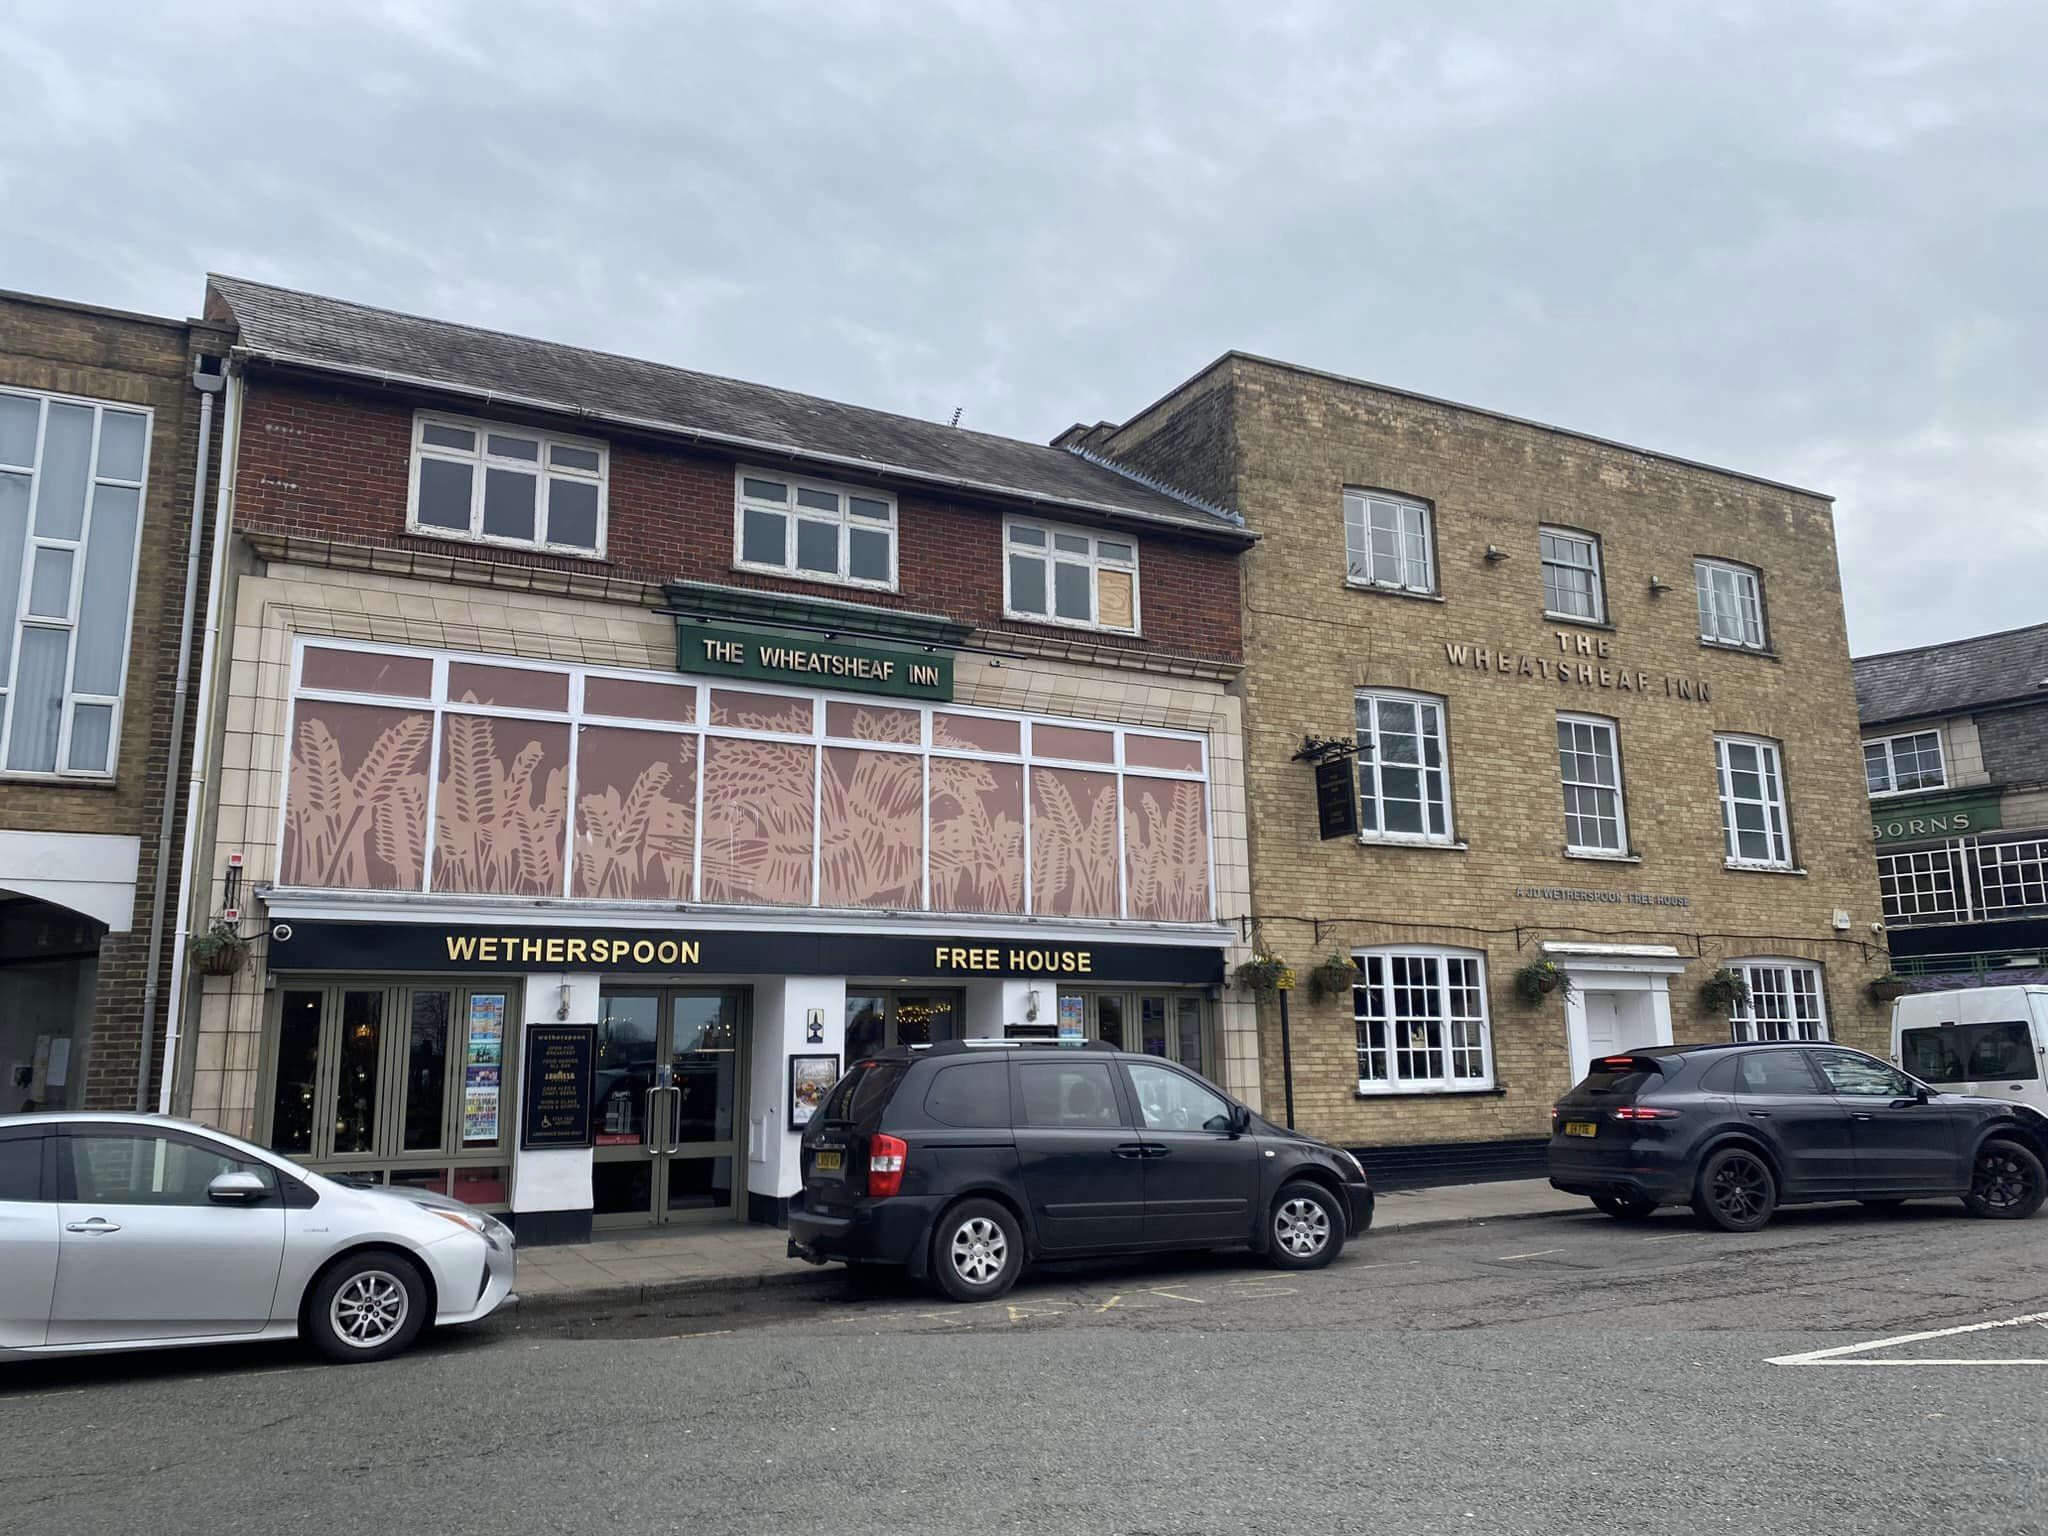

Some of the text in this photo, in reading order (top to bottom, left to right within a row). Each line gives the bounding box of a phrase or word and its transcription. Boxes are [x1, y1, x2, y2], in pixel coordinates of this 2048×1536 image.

[1556, 631, 1610, 659] THE
[703, 639, 939, 686] THE WHEATSHEAF INN
[1445, 643, 1712, 702] WHEATSHEAF INN
[1516, 887, 1691, 907] A JD WETHERSPOON FREE HOUSE
[446, 936, 700, 964] WETHERSPOON
[935, 947, 1092, 973] FREE HOUSE
